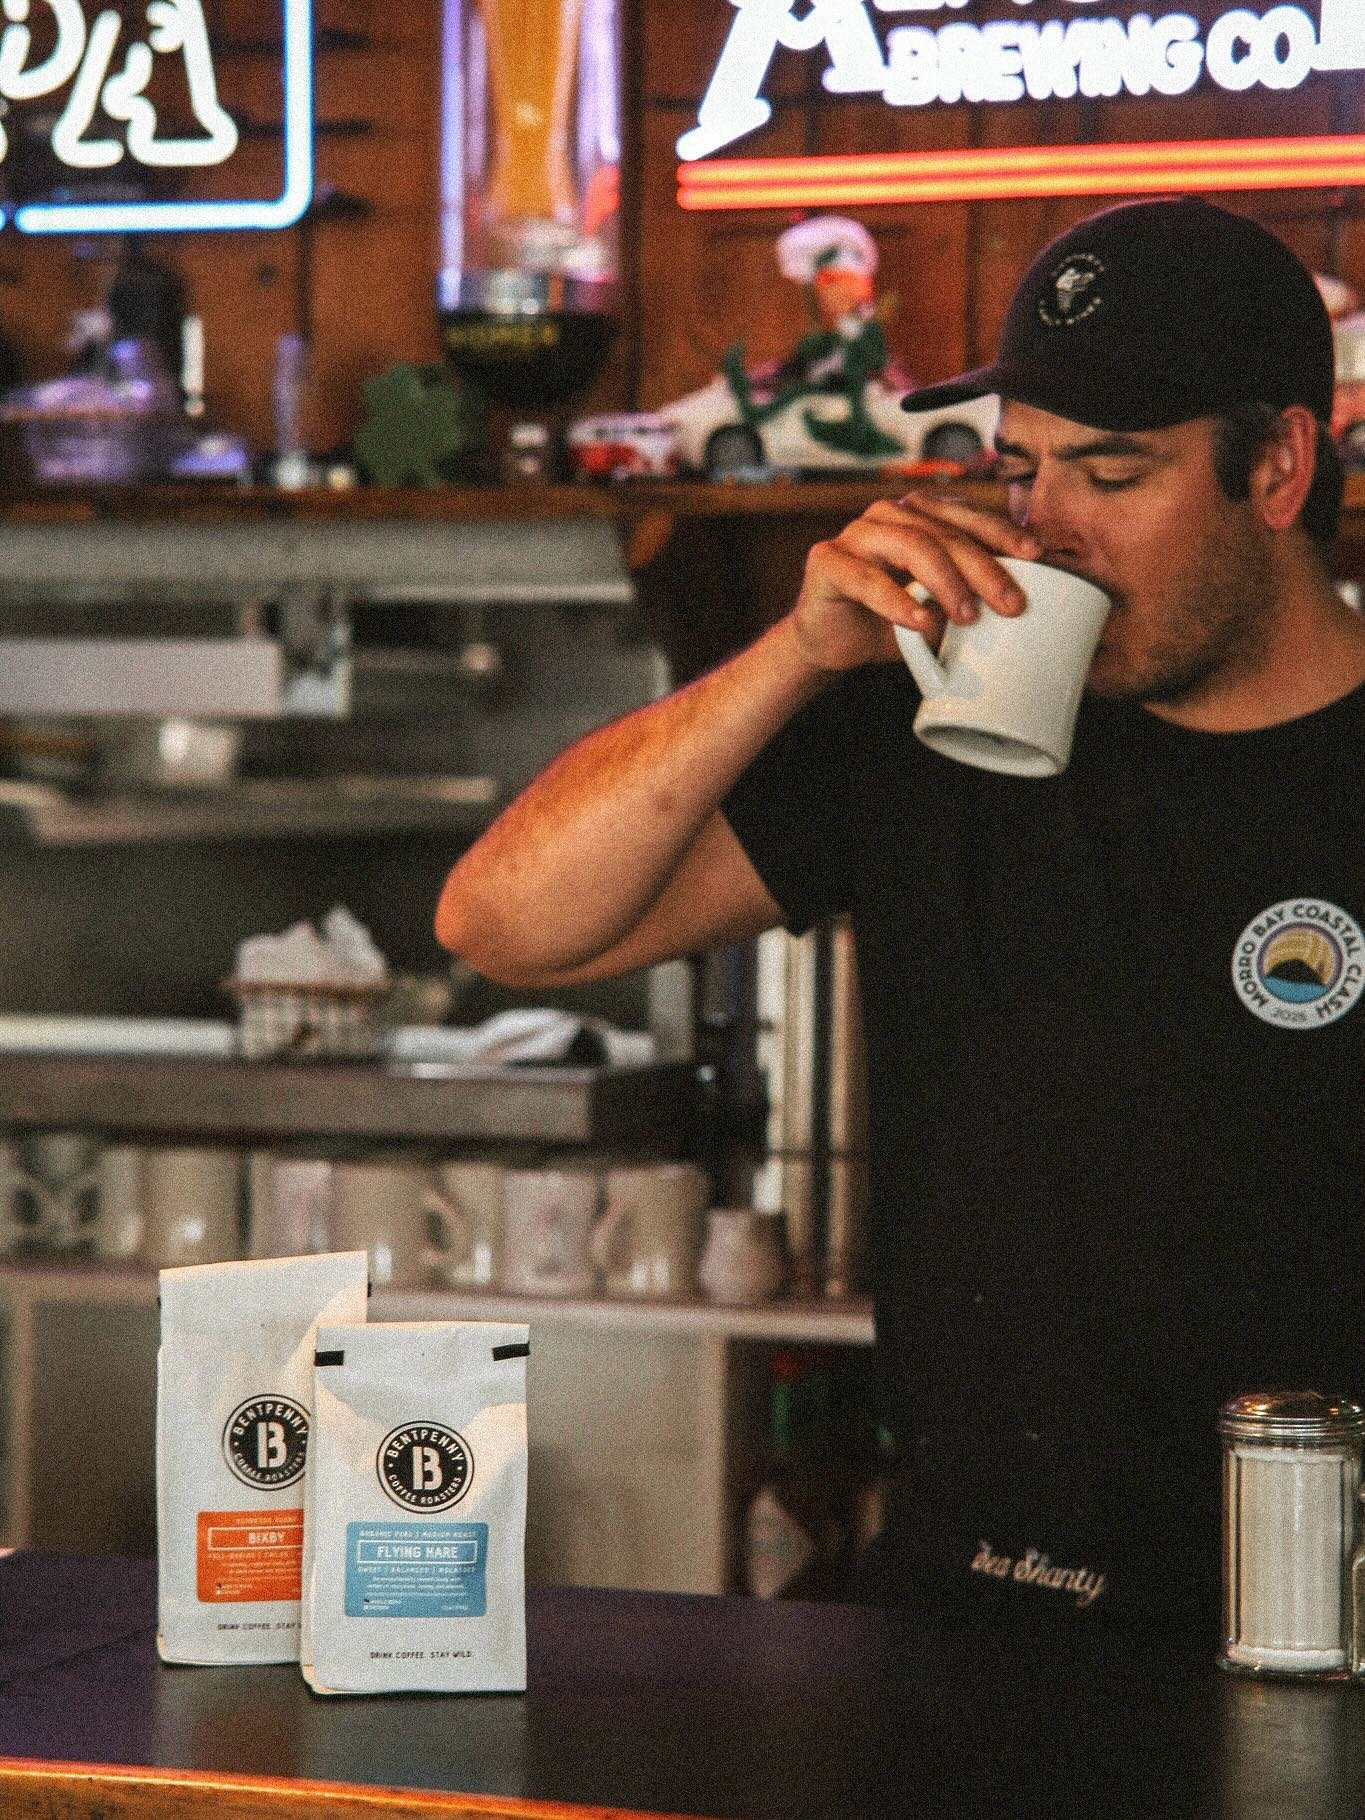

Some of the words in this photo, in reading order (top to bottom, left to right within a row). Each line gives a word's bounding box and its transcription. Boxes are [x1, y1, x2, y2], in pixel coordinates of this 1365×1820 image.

[883, 14, 1204, 105] BREWING
[1252, 907, 1285, 937] BAY
[1293, 904, 1361, 958] COASTAL
[1238, 940, 1270, 1008] MORRO
[233, 1403, 309, 1436] BENTPENNY
[257, 1421, 288, 1468] B
[386, 1429, 465, 1461] BENTPENNY
[412, 1446, 443, 1490] B
[388, 1473, 417, 1503] COFFEE
[420, 1476, 463, 1504] ROASTERS
[248, 1531, 286, 1545] BIXBY
[377, 1545, 422, 1559] FLYING
[425, 1546, 459, 1559] HARE
[429, 1651, 450, 1659] STAY
